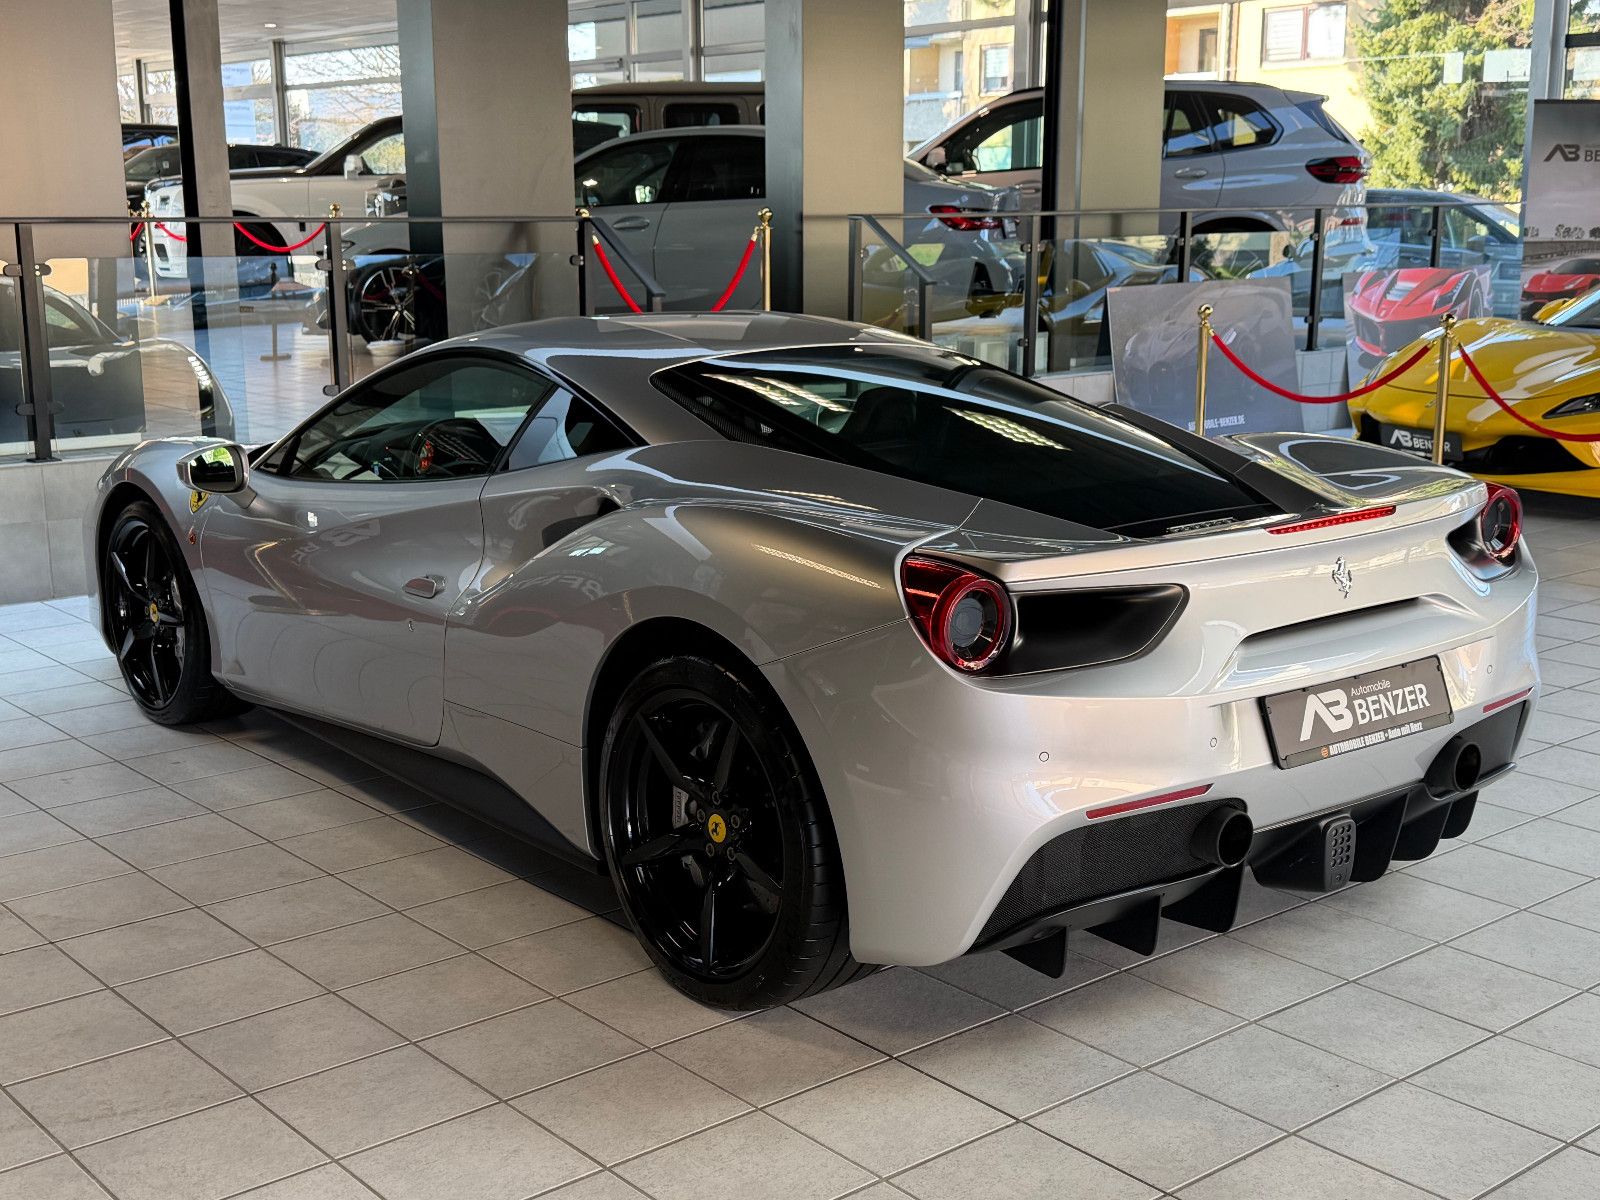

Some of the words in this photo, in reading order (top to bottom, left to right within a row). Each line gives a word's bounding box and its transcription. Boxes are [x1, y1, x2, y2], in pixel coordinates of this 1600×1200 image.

[1544, 144, 1580, 161] AB
[1390, 429, 1412, 447] AB
[1413, 438, 1450, 452] BENR
[1351, 680, 1391, 696] Automobile
[1300, 688, 1353, 741] AB
[1353, 684, 1430, 725] BENZER
[1329, 738, 1365, 755] AUTOMOBILE
[1365, 732, 1384, 746] BENZER
[1388, 729, 1401, 738] Auto
